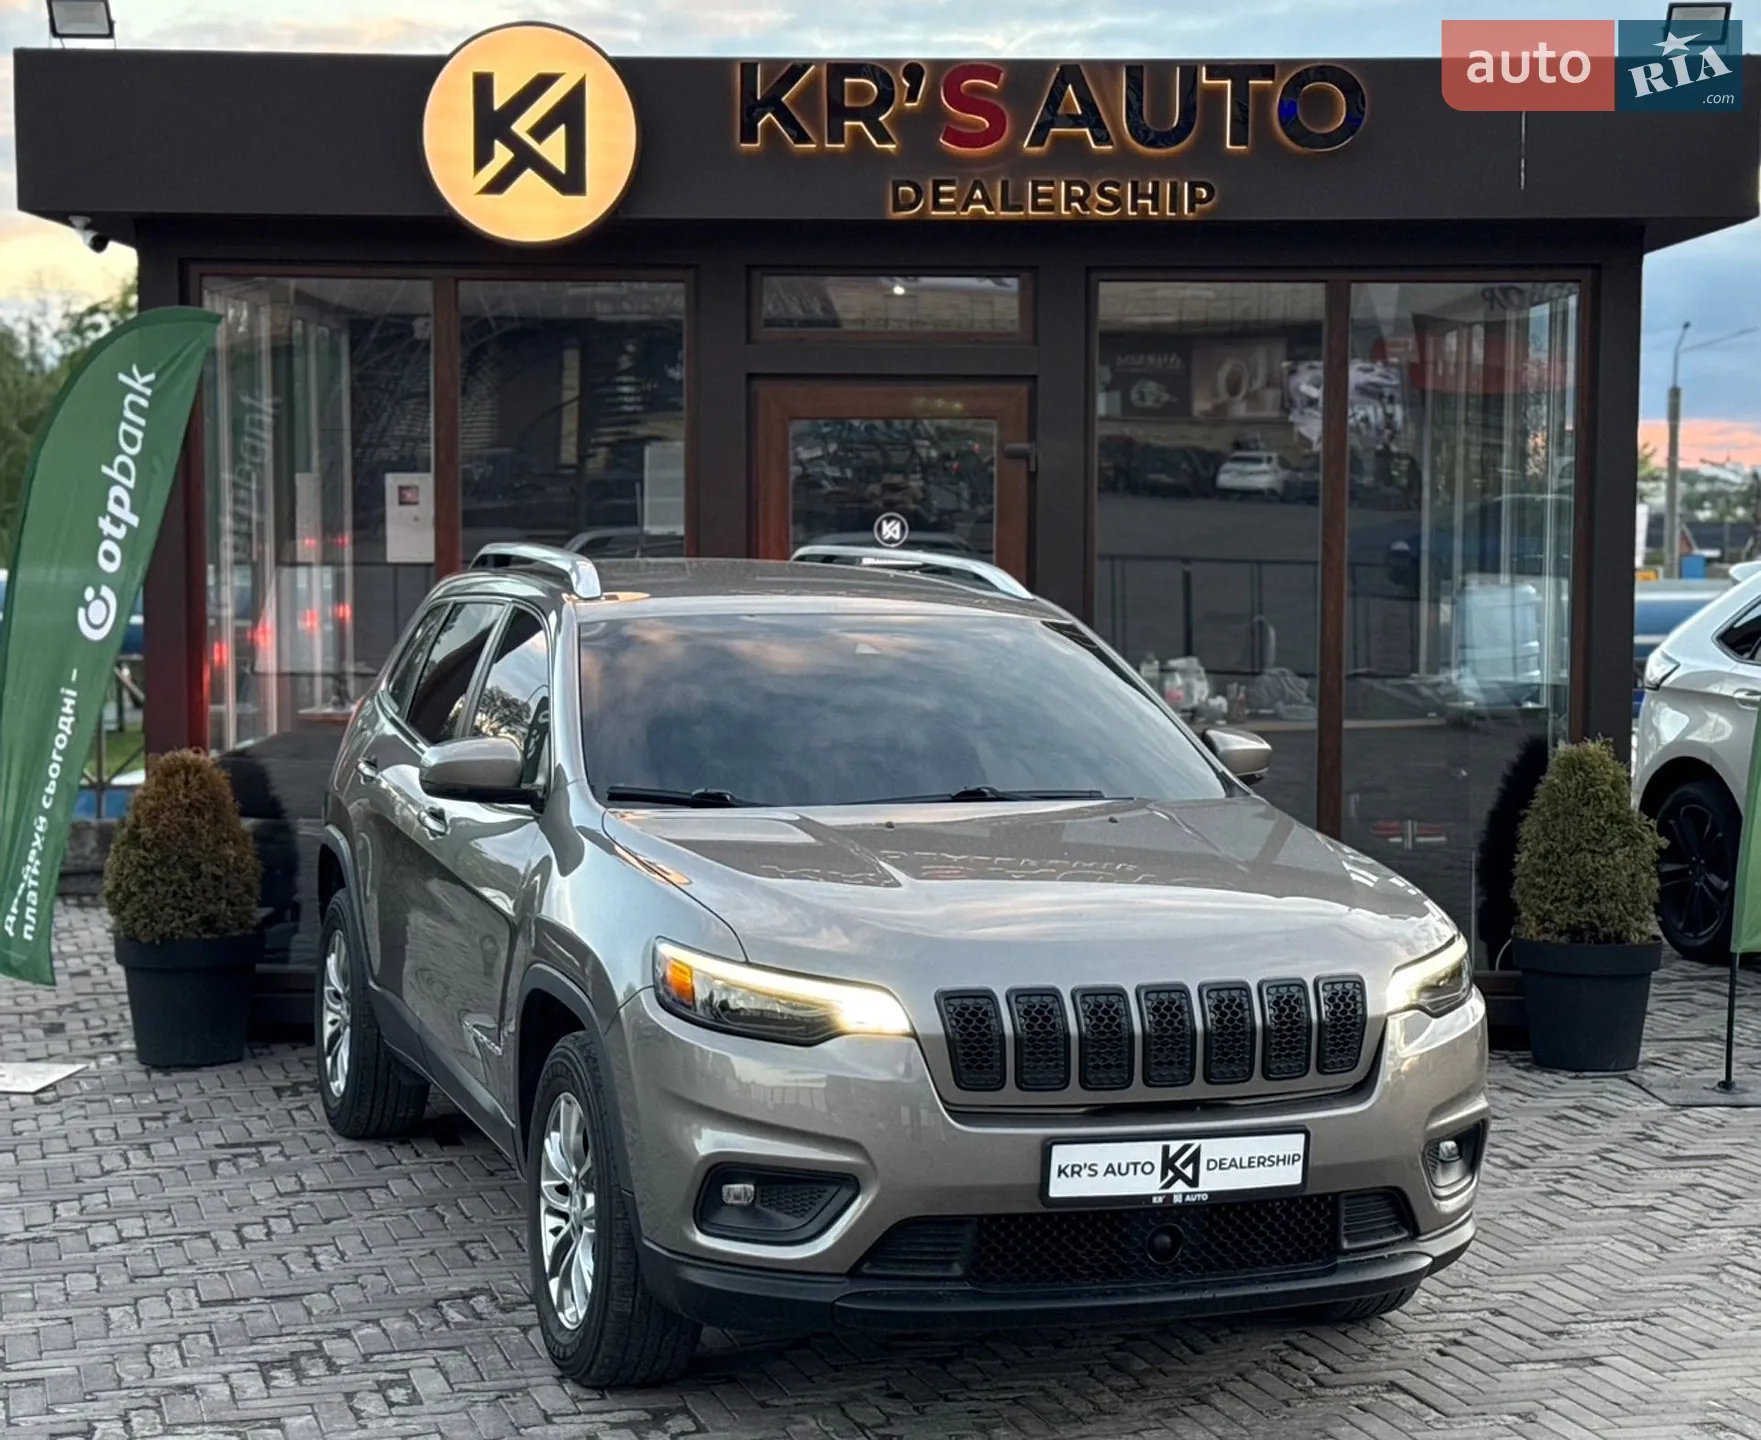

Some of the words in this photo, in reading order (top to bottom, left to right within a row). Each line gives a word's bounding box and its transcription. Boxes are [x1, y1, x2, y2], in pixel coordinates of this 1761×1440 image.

[1023, 63, 1366, 151] AUTO
[891, 178, 1217, 215] DEALERSHIP
[97, 363, 156, 574] otpbank
[42, 687, 79, 810] сьогодні
[1103, 1161, 1156, 1178] AUTO
[1206, 1153, 1302, 1172] DEALERSHIP
[1185, 1193, 1209, 1203] AUTO
